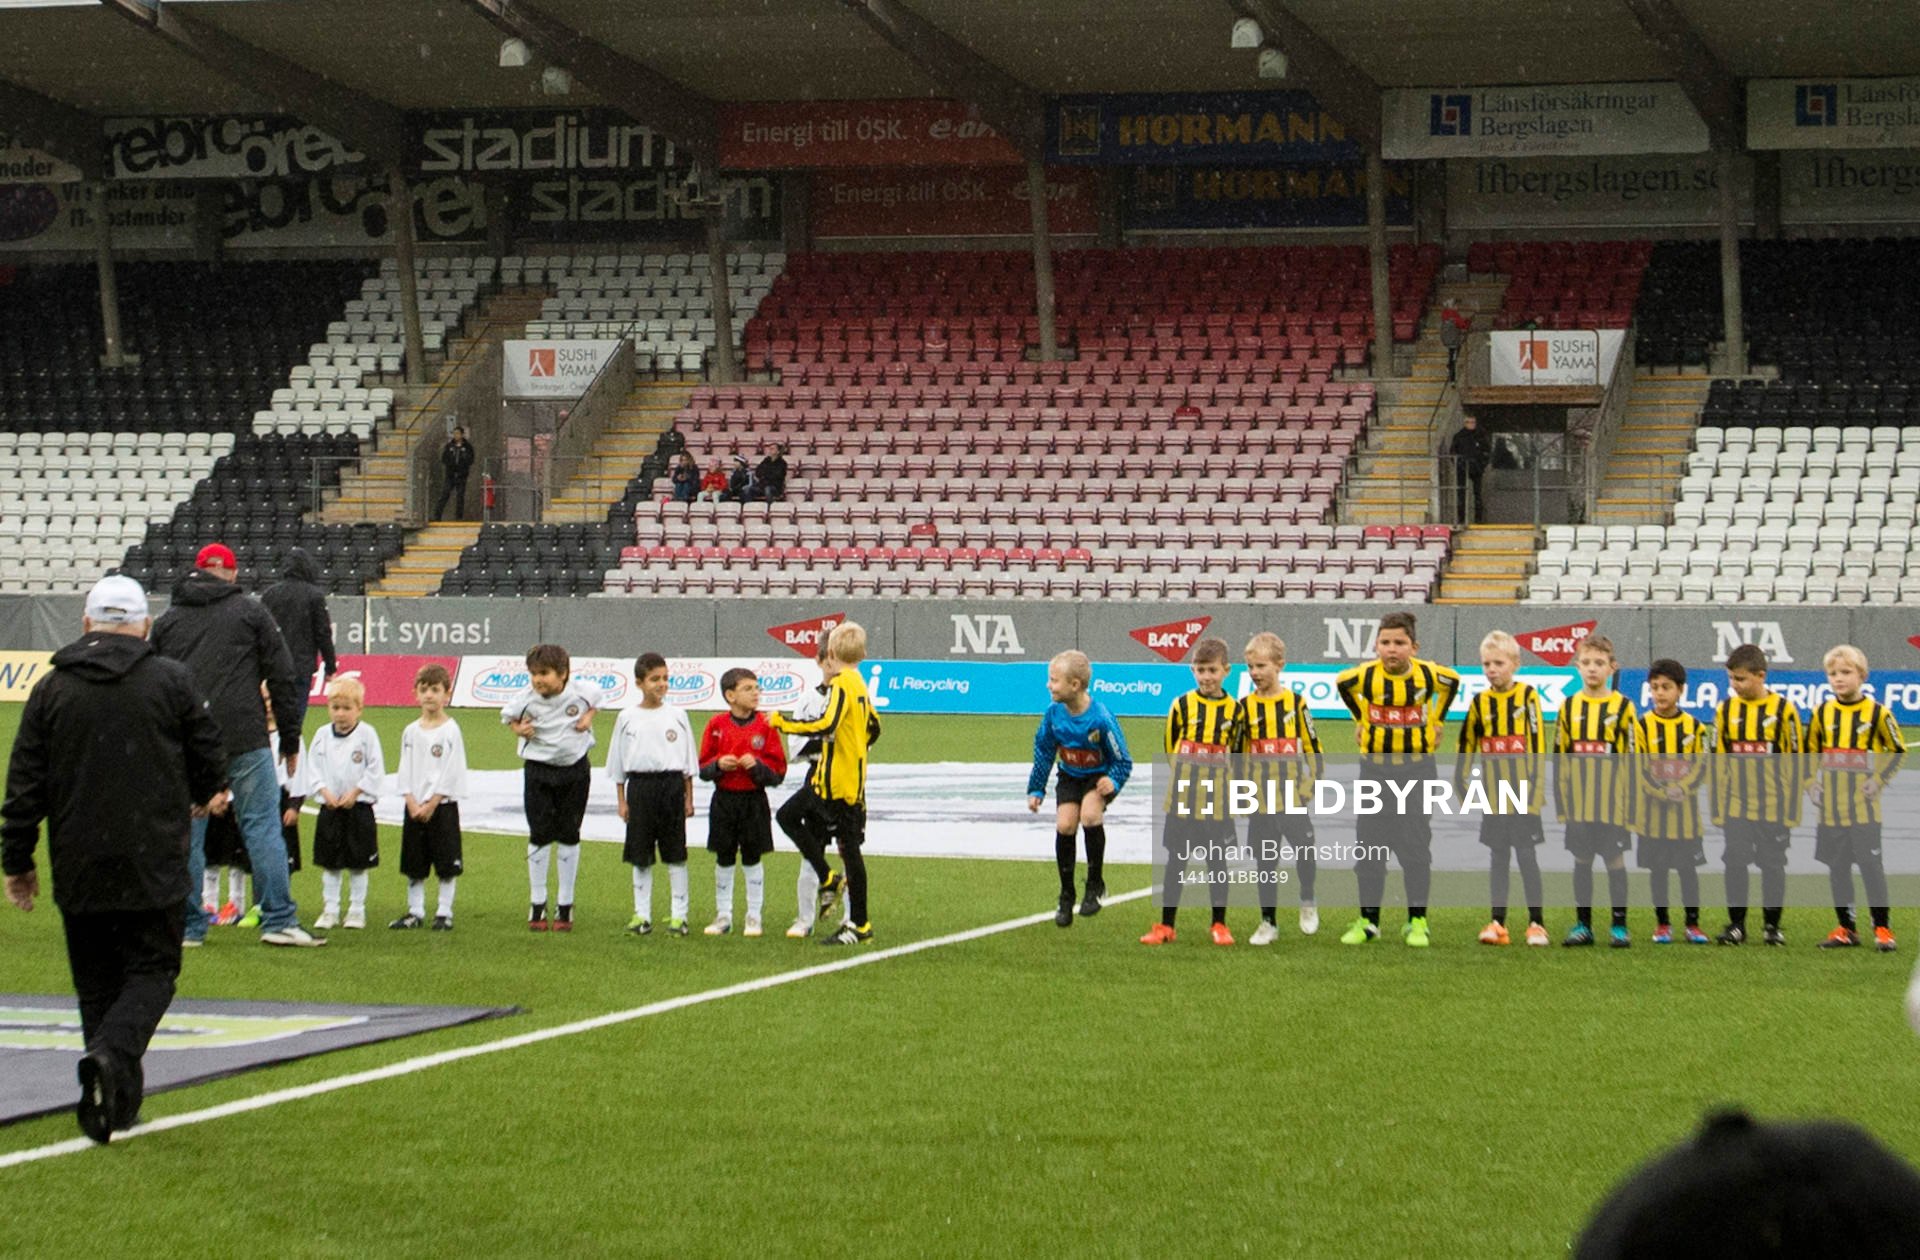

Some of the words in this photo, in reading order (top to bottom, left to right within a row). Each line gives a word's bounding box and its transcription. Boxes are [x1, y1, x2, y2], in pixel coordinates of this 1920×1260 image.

[1481, 92, 1658, 116] Länsförsäkringar
[743, 121, 812, 147] Energi
[821, 118, 849, 142] till
[1481, 116, 1593, 140] Bergslagen
[1552, 339, 1595, 353] SUSHI
[558, 348, 597, 361] SUSHI
[1553, 356, 1596, 369] YAMA
[559, 363, 597, 376] YAMA
[399, 617, 490, 649] synas!
[822, 620, 837, 630] UP
[1186, 623, 1202, 634] UP
[1571, 627, 1589, 639] UP
[951, 614, 1024, 654] NA
[1149, 633, 1189, 648] BACK
[1712, 621, 1793, 663] NA
[1531, 637, 1575, 653] BACK
[903, 676, 970, 693] Recycling
[1094, 680, 1162, 696] Recycling
